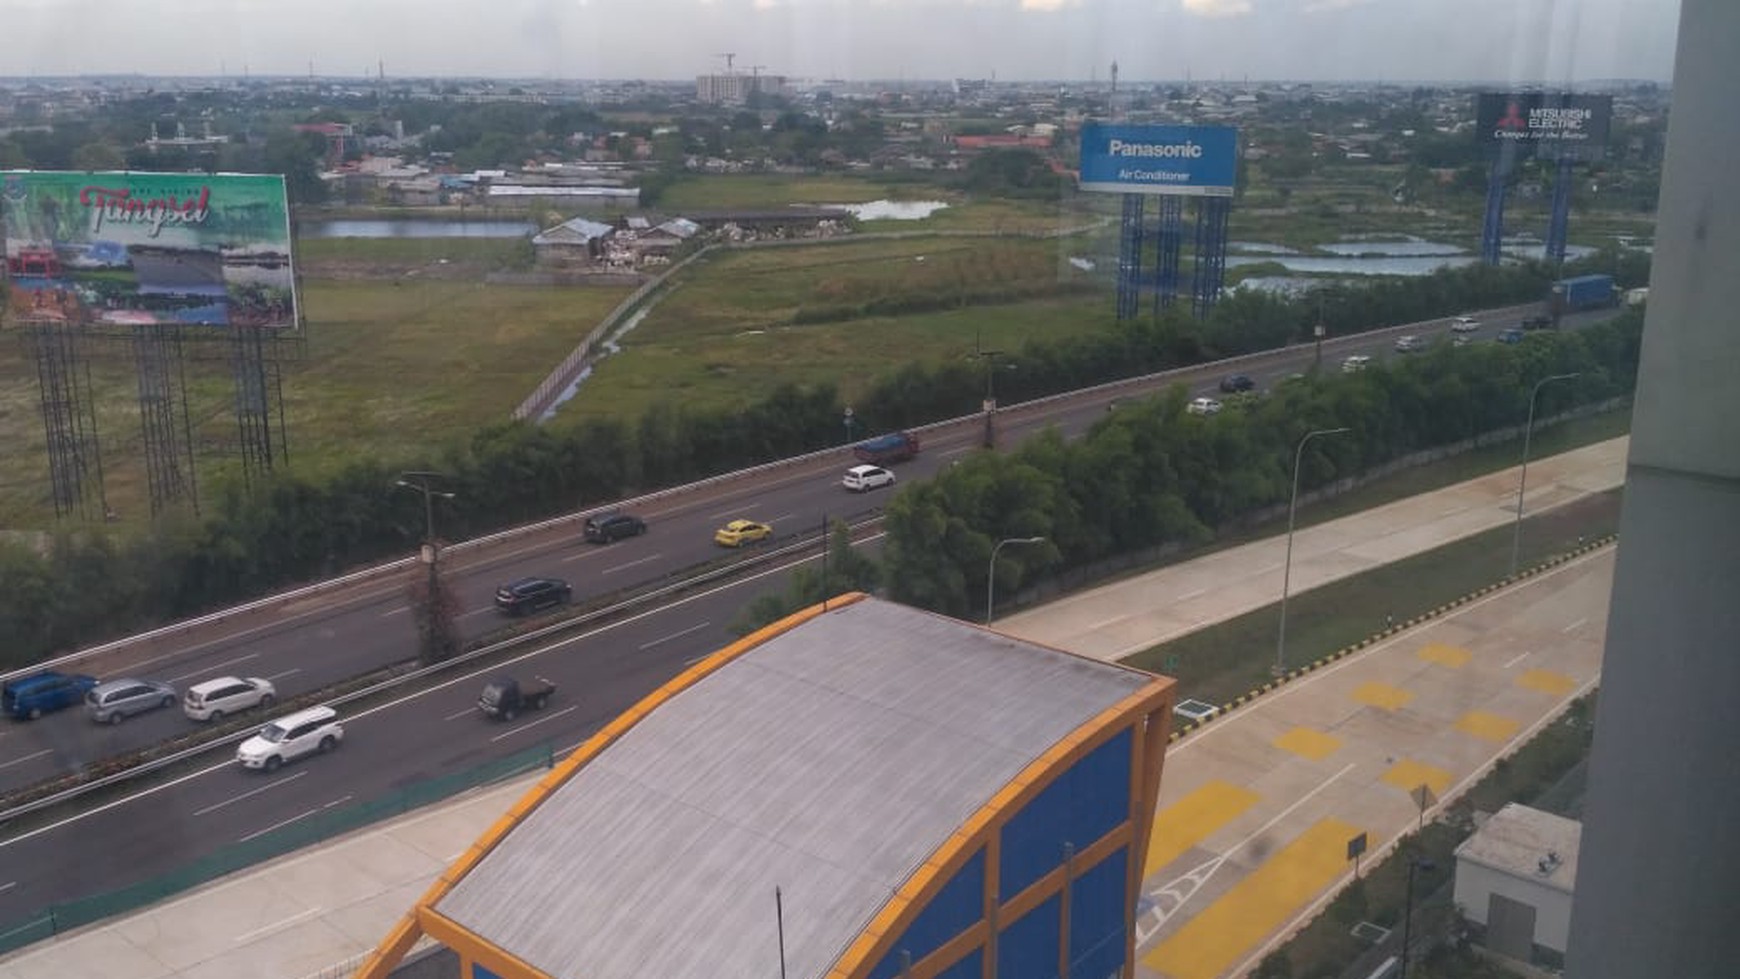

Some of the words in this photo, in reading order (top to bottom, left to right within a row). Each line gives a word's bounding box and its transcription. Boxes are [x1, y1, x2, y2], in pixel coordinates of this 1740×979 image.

[1529, 108, 1592, 119] MITSUBISHI
[1528, 119, 1583, 129] ELECTRIC
[1108, 139, 1203, 158] Panasonic
[1118, 169, 1134, 180] Air
[1134, 169, 1191, 182] Conditioner
